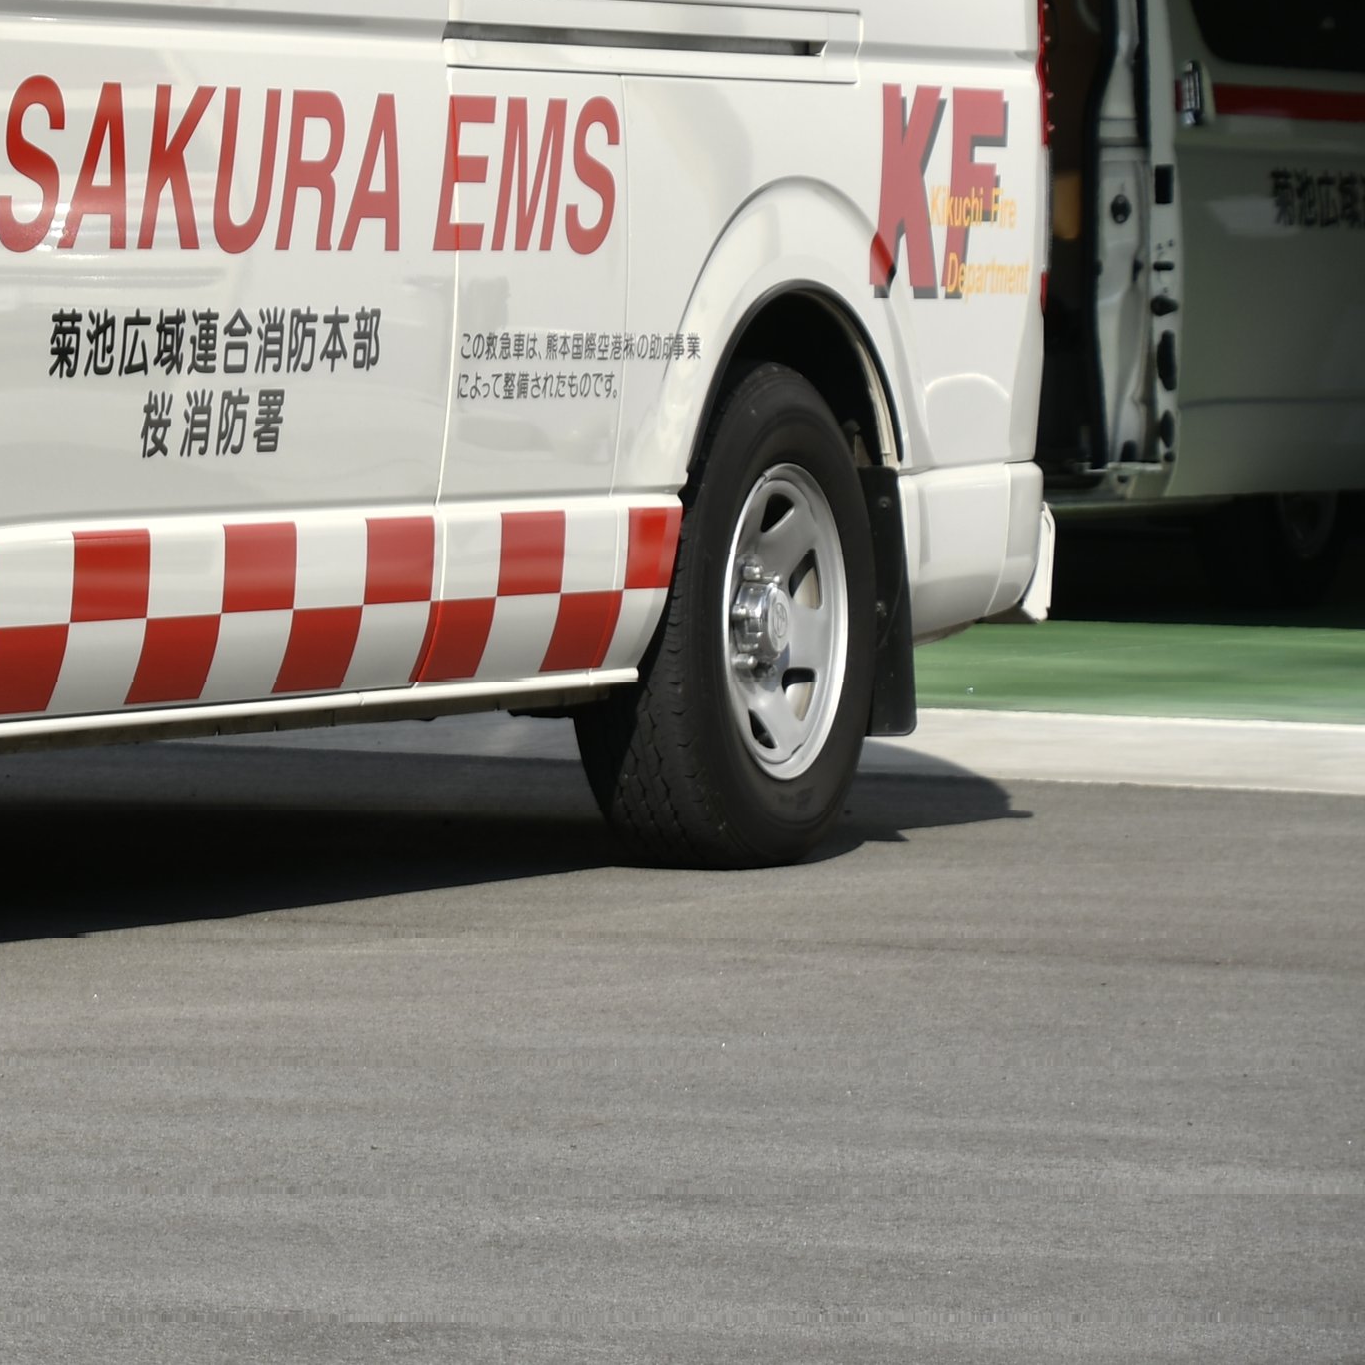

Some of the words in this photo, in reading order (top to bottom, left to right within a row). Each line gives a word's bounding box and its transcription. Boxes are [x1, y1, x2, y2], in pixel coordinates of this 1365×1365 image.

[432, 94, 621, 256] EMS
[869, 82, 1009, 299] KF
[930, 186, 983, 226] Kikuchi
[990, 187, 1017, 229] Fire
[947, 252, 1029, 303] Department
[49, 306, 381, 378] 菊池広域連合消防本部
[457, 371, 618, 400] によって整備されたものです。
[141, 388, 285, 458] 桜消防署
